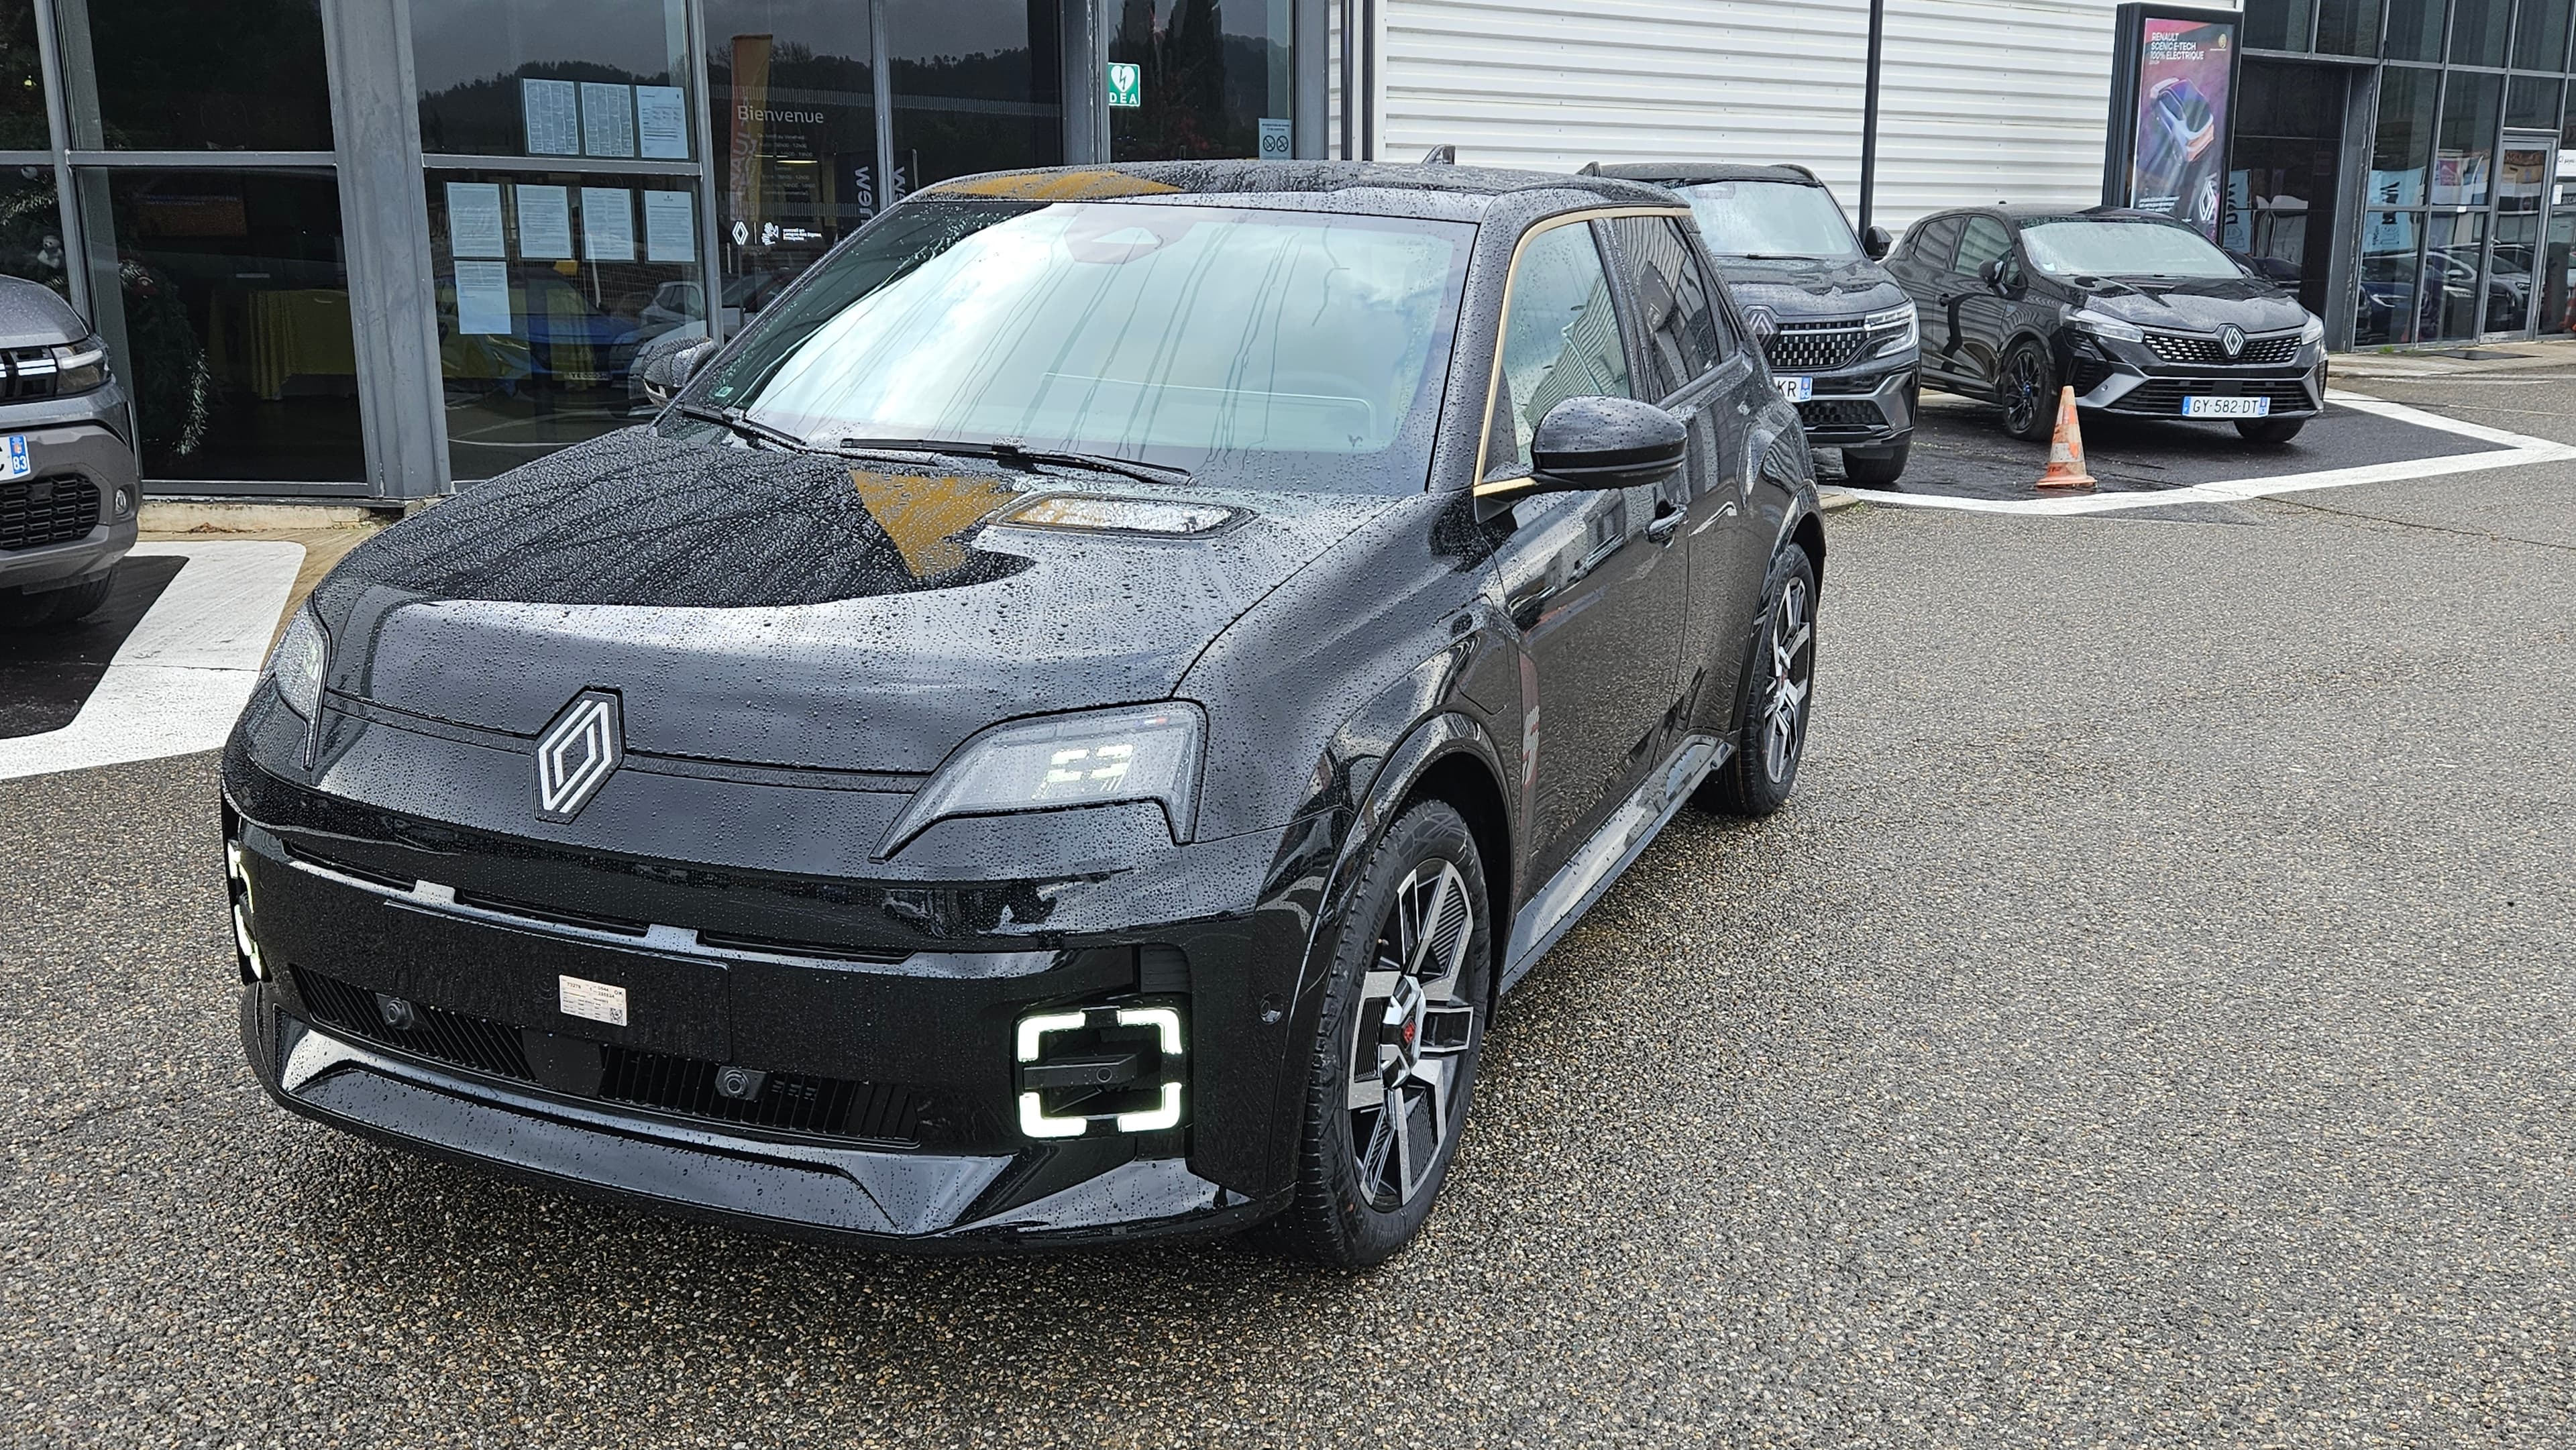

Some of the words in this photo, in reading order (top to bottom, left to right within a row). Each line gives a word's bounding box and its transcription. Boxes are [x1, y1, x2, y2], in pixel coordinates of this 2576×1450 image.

[2151, 32, 2179, 41] RENAULT
[2151, 42, 2173, 50] SCENIC
[2174, 42, 2197, 50] E-TECH
[2150, 50, 2165, 60] 100%
[2166, 51, 2204, 60] ELECTRIQUE
[1109, 92, 1137, 104] DEA
[737, 105, 824, 123] Bienvenue
[1777, 380, 1797, 397] KR
[2193, 400, 2259, 413] GY-582-DT
[13, 455, 27, 471] 83
